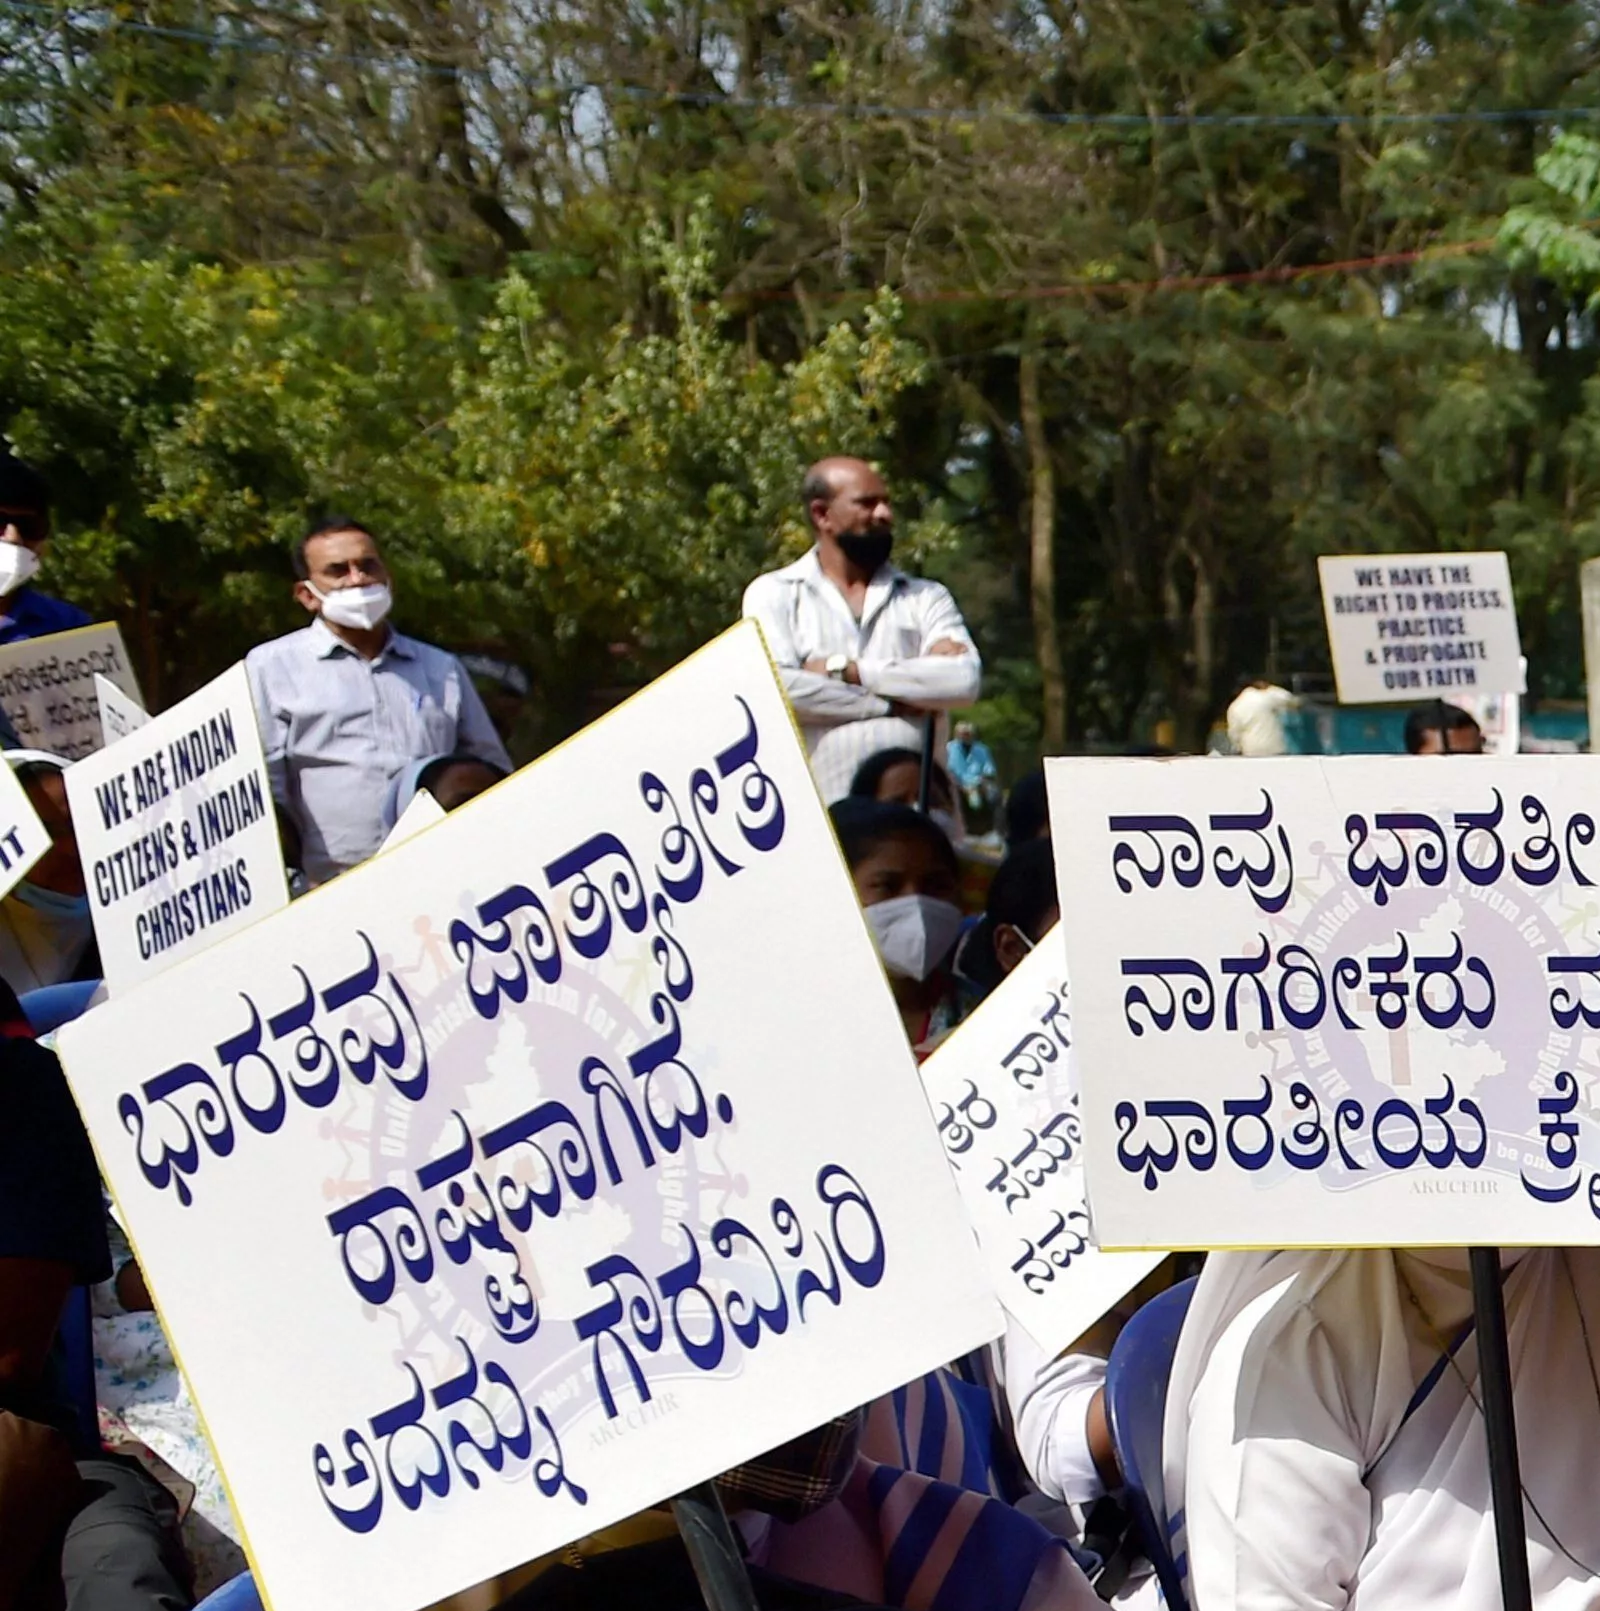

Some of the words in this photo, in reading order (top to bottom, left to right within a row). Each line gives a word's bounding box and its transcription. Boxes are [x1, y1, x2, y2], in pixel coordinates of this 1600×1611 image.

[1334, 593, 1388, 613] RIGHT
[1395, 592, 1417, 611] TO
[1355, 567, 1383, 587] WE
[1389, 566, 1434, 586] HAVE
[1441, 565, 1472, 584] THE
[1378, 616, 1467, 638] PRACTICE
[1383, 670, 1421, 689] OUR
[1426, 667, 1477, 687] FAITH
[93, 769, 129, 832] WE
[131, 749, 170, 808] ARE
[170, 707, 239, 792] INDIAN
[92, 822, 179, 908] CITIZENS
[181, 818, 198, 860] &
[199, 767, 267, 851] INDIAN
[1109, 789, 1292, 913] ನಾವು
[135, 857, 252, 961] CHRISTIANS
[1121, 932, 1495, 1036] ನಾಗರೀಕರು
[119, 932, 428, 1206] ಭಾರತವು
[1115, 1074, 1486, 1190] ಭಾರತೀಯ
[315, 1337, 587, 1533] ಅದನ್ನು
[574, 1165, 884, 1418] ಗೌರವಿಸಿರಿ
